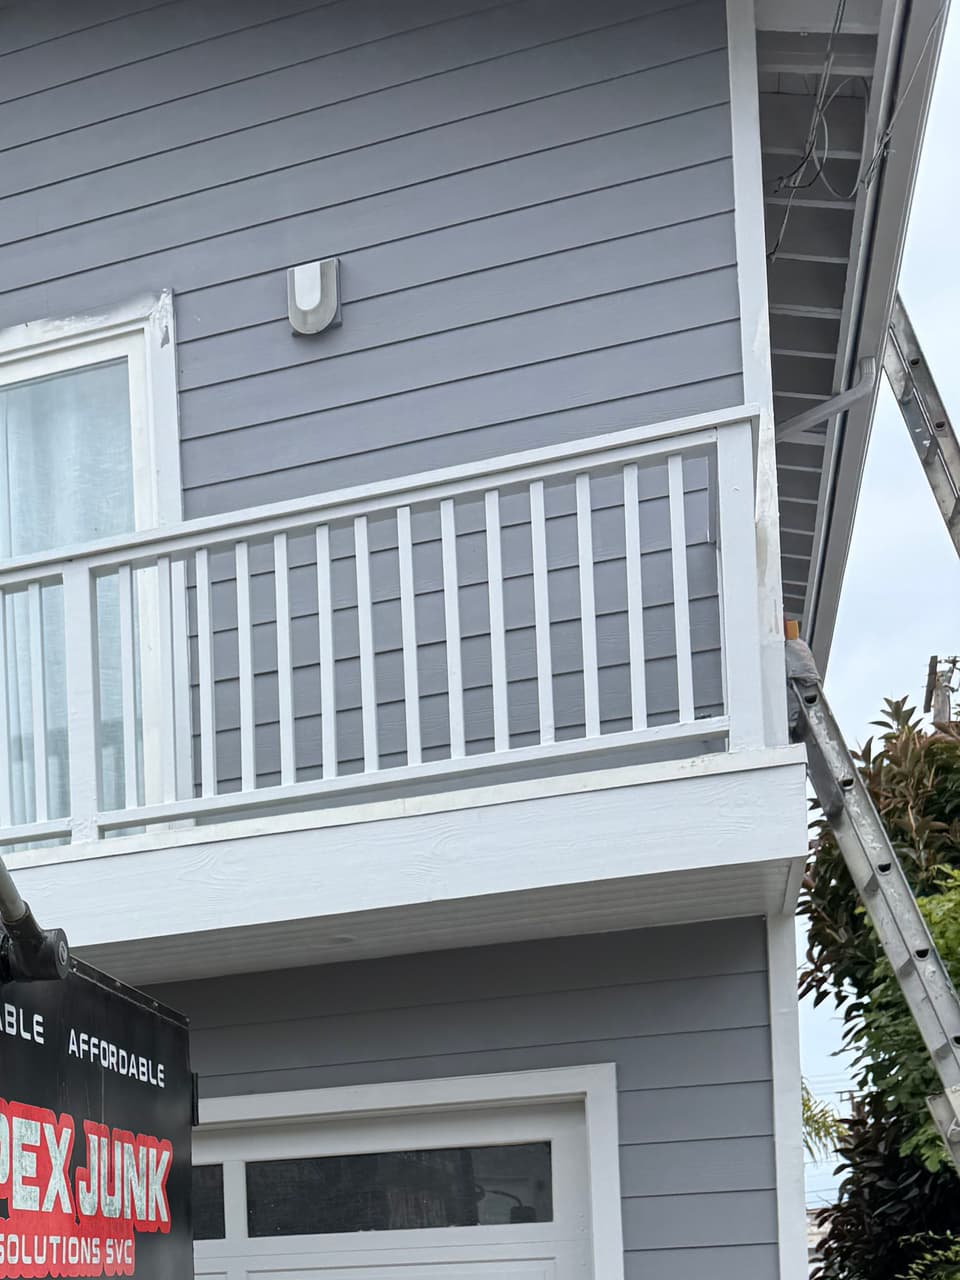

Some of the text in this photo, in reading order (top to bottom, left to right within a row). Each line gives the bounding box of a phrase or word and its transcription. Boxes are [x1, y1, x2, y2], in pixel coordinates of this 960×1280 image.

[69, 1029, 165, 1088] AFFORDABLE
[78, 1134, 171, 1223] JUNK
[105, 1238, 134, 1265] SVC
